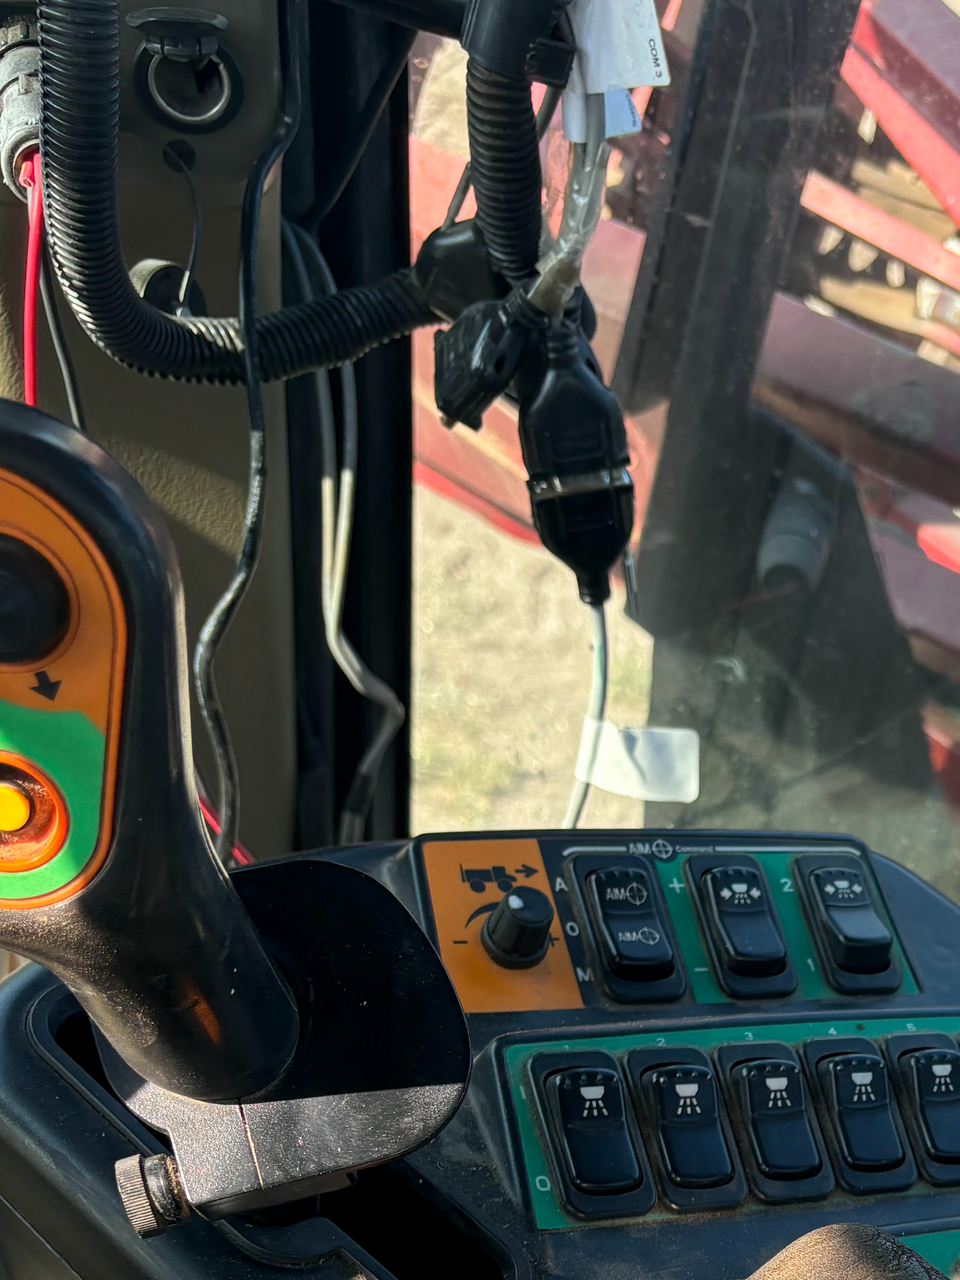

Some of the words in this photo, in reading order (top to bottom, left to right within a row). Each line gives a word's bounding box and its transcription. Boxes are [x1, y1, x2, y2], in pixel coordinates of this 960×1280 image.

[649, 38, 660, 67] COM
[655, 70, 662, 78] 3
[629, 842, 651, 855] AIM
[555, 877, 569, 892] A
[780, 878, 795, 893] 2
[606, 887, 627, 900] AIM
[576, 967, 594, 982] M
[828, 1027, 837, 1036] 4
[906, 1023, 916, 1032] 5
[656, 1037, 667, 1047] 2
[744, 1031, 754, 1041] 3
